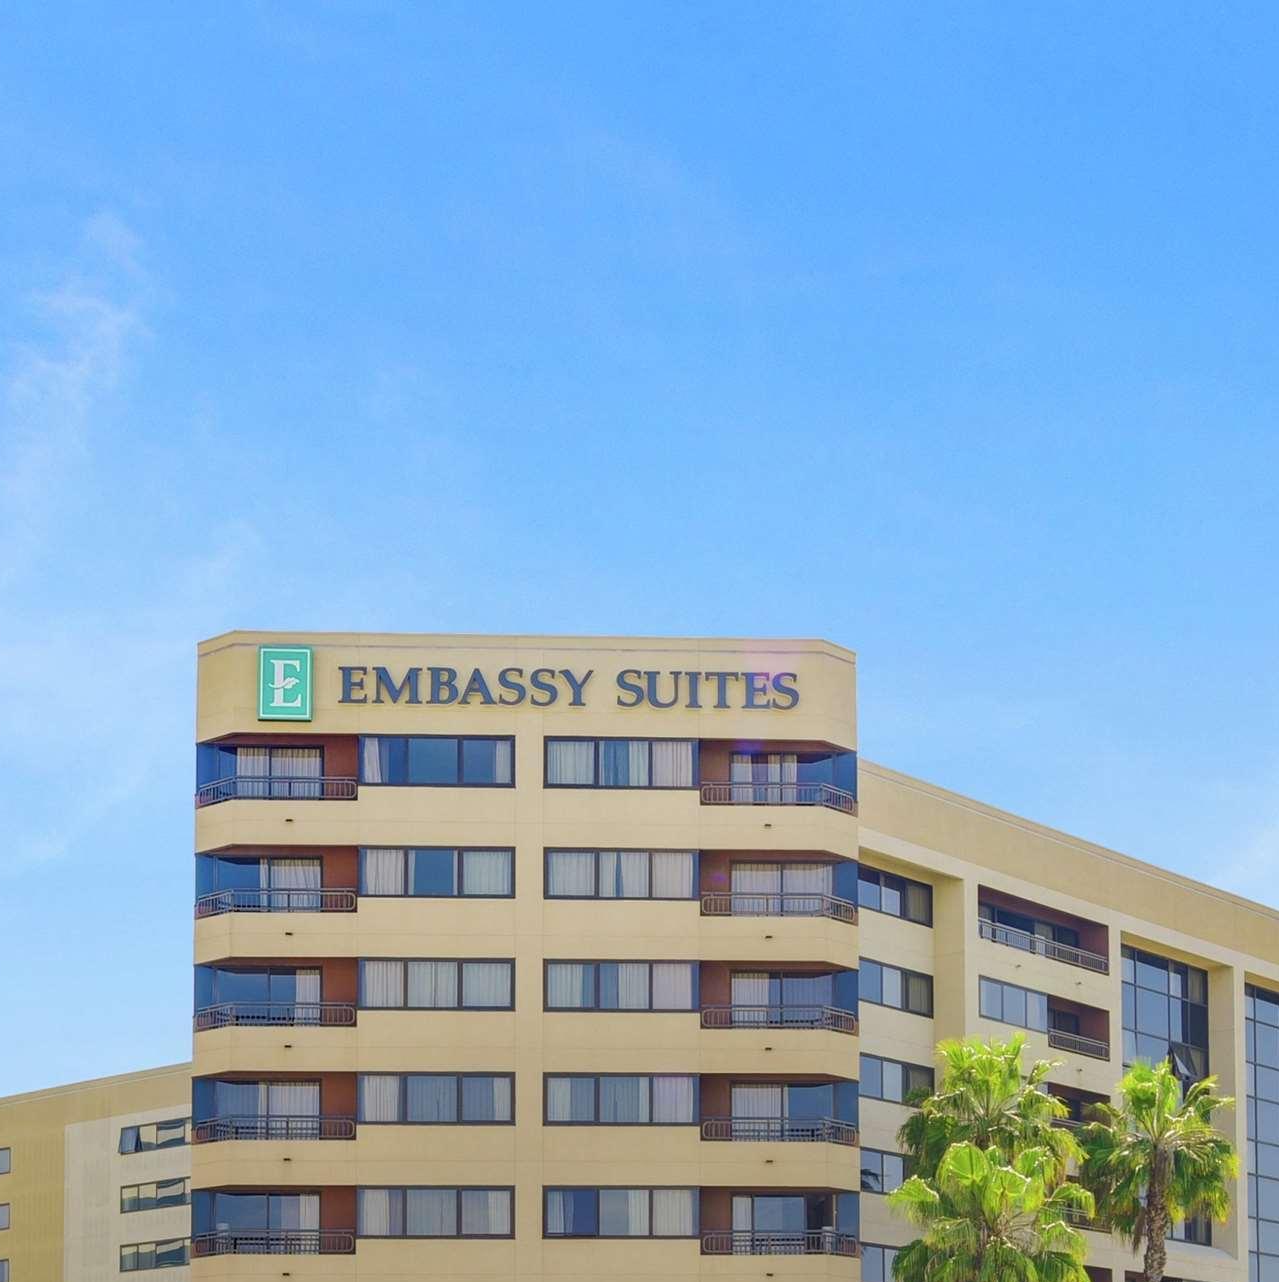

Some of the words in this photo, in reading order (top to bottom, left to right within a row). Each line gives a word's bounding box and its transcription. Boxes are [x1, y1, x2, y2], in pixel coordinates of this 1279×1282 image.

[268, 659, 302, 707] E
[337, 665, 595, 707] EMBASSY
[615, 668, 801, 711] SUITES
